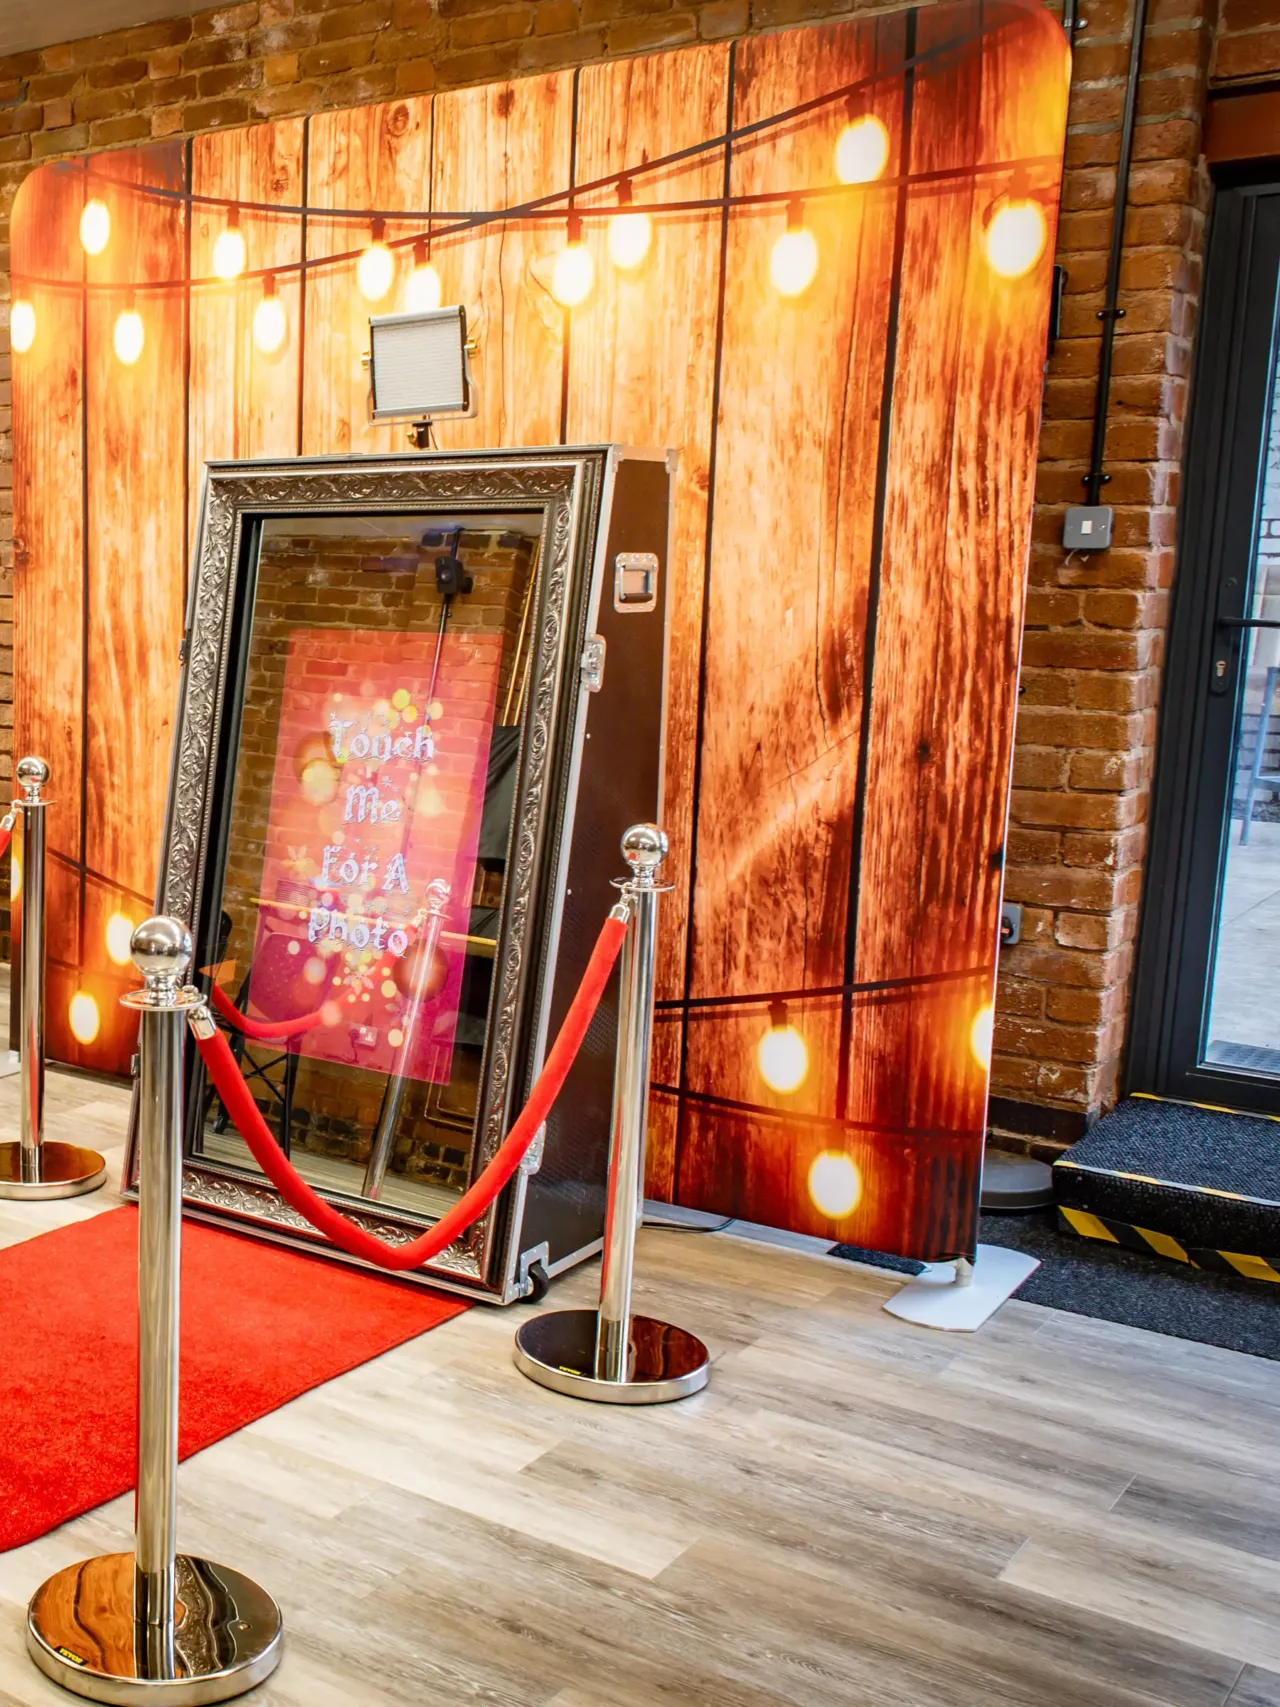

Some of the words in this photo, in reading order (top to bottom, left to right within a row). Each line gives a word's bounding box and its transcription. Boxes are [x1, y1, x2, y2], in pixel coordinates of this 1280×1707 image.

[328, 719, 435, 763] Touch
[344, 784, 401, 824] Me
[322, 845, 378, 885] For
[381, 852, 410, 893] A
[308, 906, 409, 955] Photo
